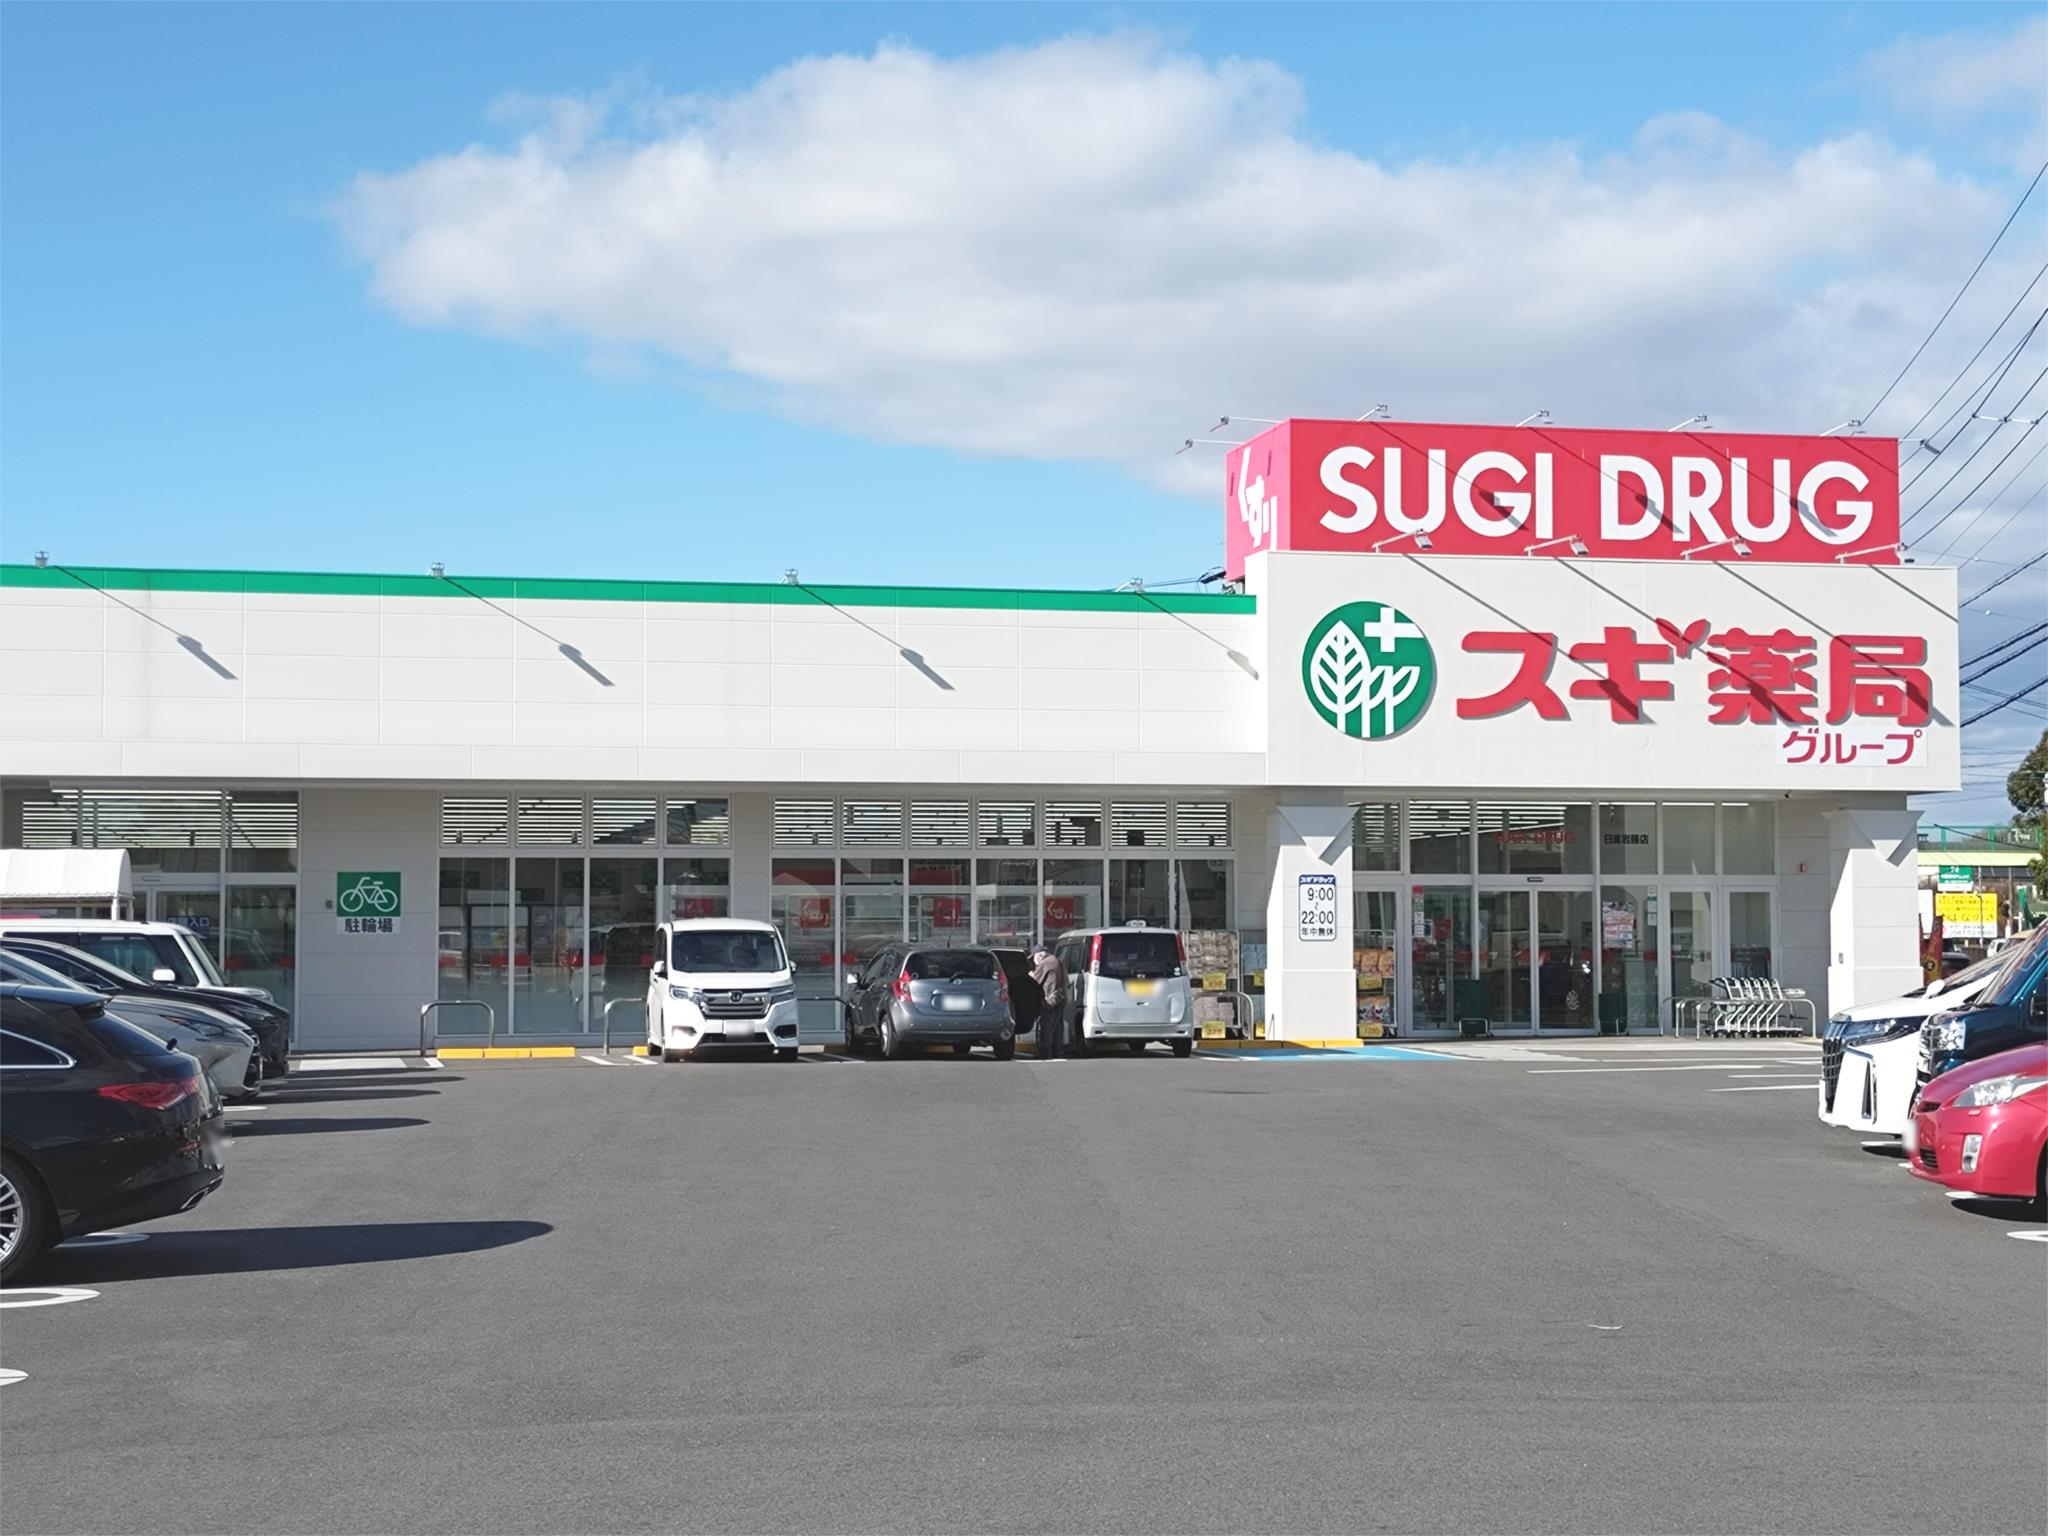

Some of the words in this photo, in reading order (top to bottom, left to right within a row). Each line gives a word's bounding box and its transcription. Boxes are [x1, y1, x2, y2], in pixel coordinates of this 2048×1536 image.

[1238, 446, 1278, 551] くすり
[1319, 446, 1554, 538] SUGI
[1600, 454, 1873, 545] DRUG
[1456, 619, 1931, 726] スギ薬局
[1784, 729, 1922, 765] グループ
[1307, 887, 1334, 901] 9:00
[344, 917, 393, 933] 駐輪場
[1301, 910, 1334, 925] 22:00
[1301, 927, 1335, 936] 年中無休
